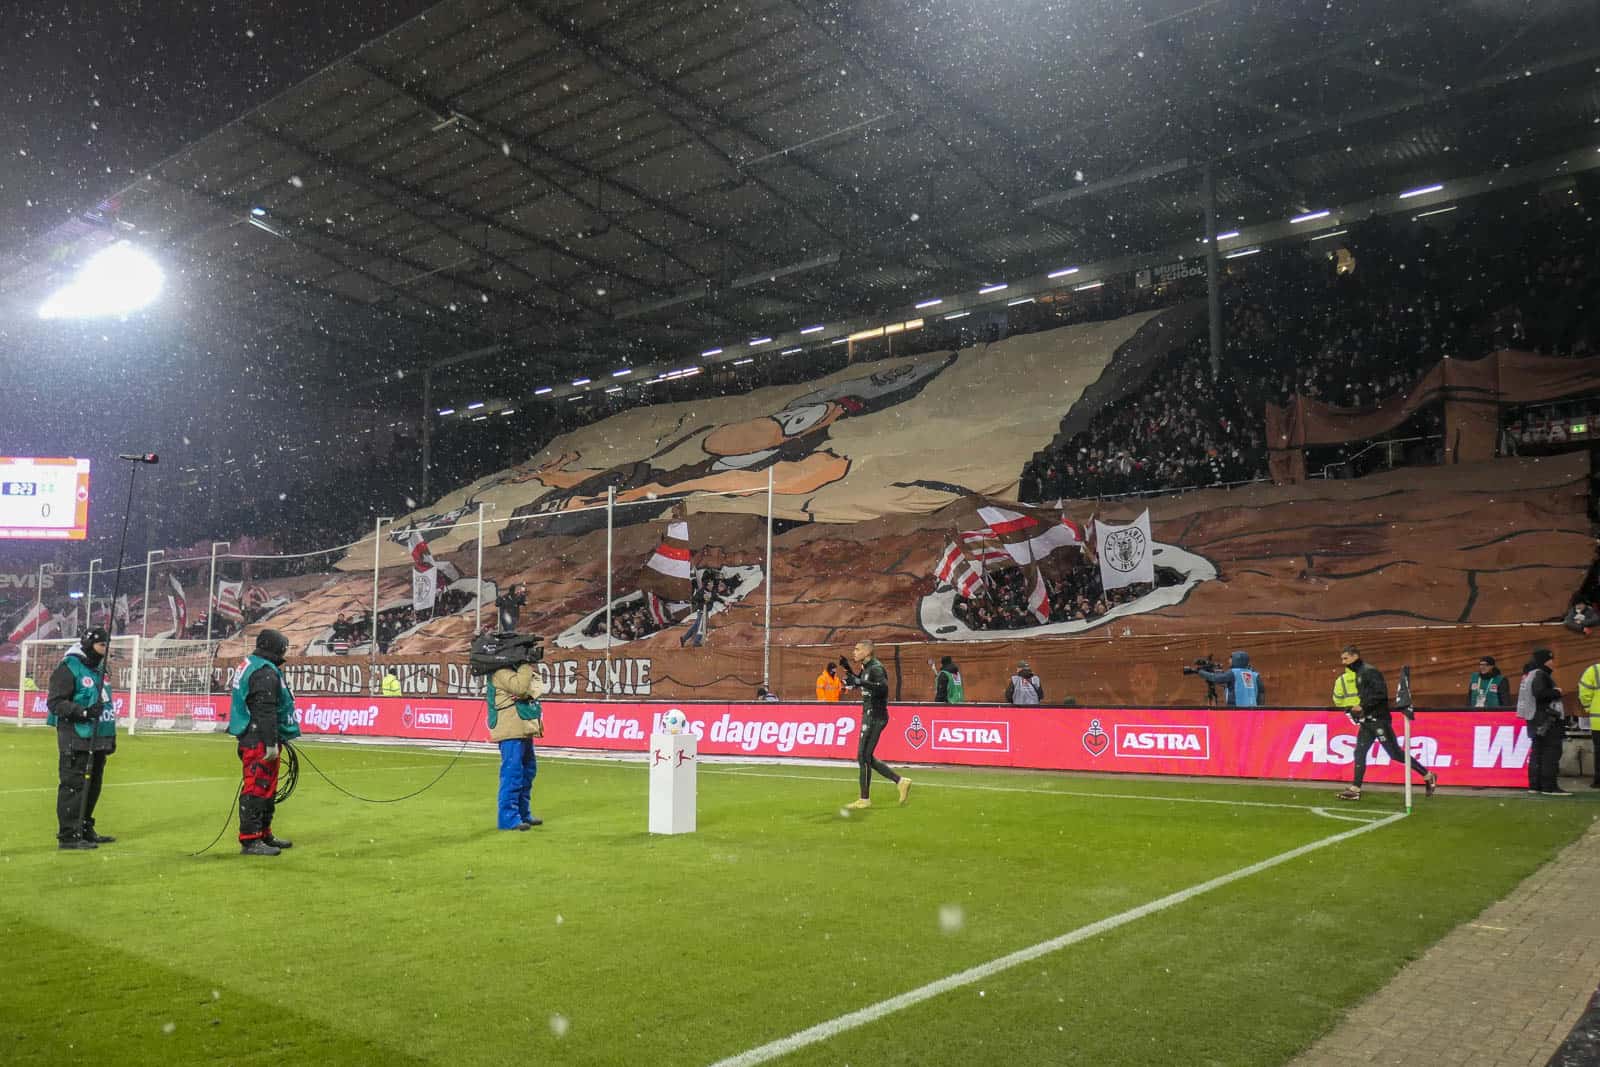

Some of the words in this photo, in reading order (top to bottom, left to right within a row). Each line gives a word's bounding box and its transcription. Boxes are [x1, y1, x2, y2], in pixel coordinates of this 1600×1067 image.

[285, 664, 362, 693] NIEMAND
[586, 658, 650, 695] KNIE
[305, 704, 379, 730] dagegen?
[418, 712, 449, 724] ASTRA
[575, 711, 644, 740] Astra.
[710, 714, 855, 752] dagegen?
[938, 727, 1002, 745] ASTRA
[1122, 732, 1201, 750] ASTRA
